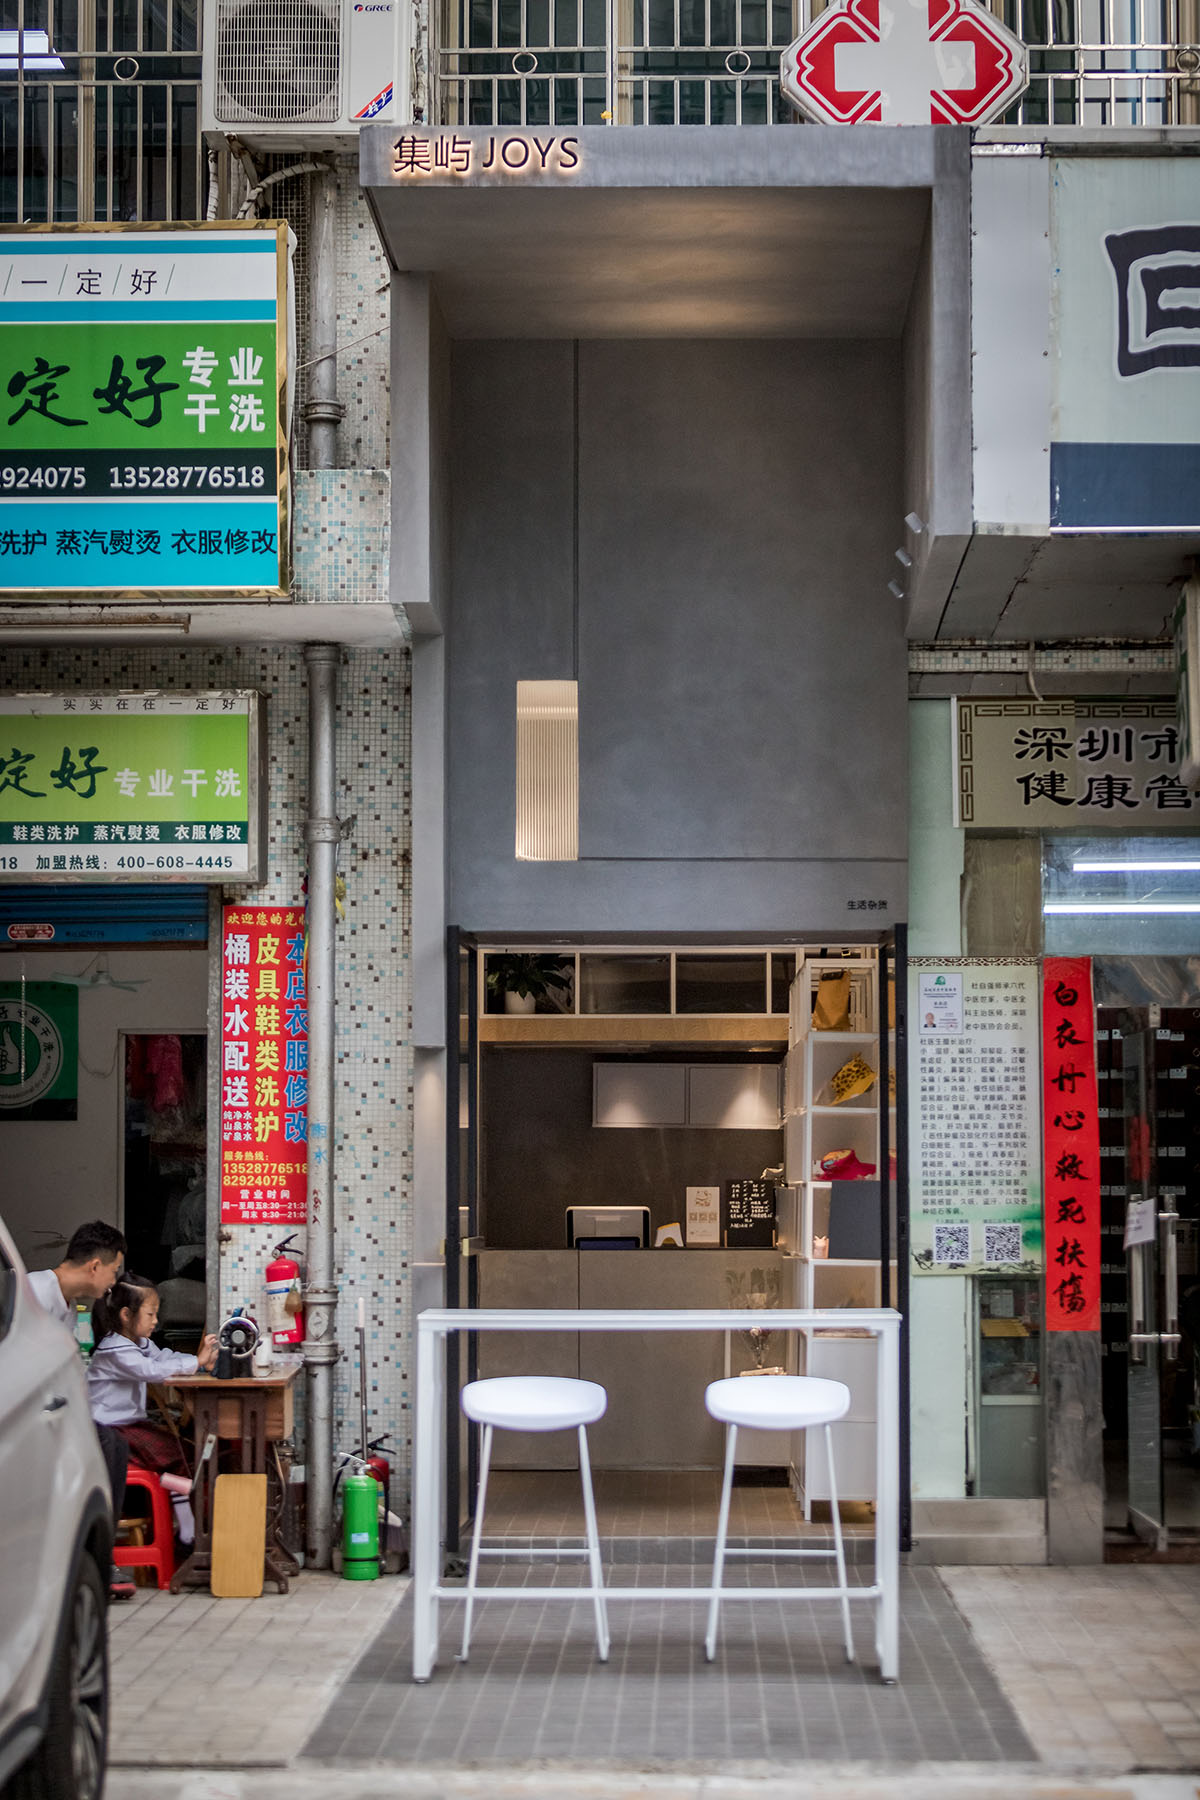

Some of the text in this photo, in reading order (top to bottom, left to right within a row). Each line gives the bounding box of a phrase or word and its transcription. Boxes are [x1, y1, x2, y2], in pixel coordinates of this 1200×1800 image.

[365, 4, 393, 12] GREE
[393, 134, 579, 173] 集屿 JOYS
[182, 346, 264, 387] 专业
[7, 354, 180, 427] 定好
[184, 393, 266, 433] 干洗
[0, 466, 265, 489] 924075 13528776518
[55, 529, 162, 556] 蒸汽熨烫
[171, 528, 278, 555] 衣服修改
[113, 768, 241, 798] 专业干洗
[1016, 770, 1200, 809] 健康管
[13, 825, 241, 841] 鞋类洗护 蒸汽熨烫 衣服修改
[116, 856, 233, 868] 400-608-4445
[847, 900, 888, 910] 生活杂货
[224, 933, 250, 1107] 桶装水配送
[254, 933, 280, 1142] 皮具鞋类洗护
[223, 1122, 252, 1131] 山泉水
[223, 1132, 252, 1141] 矿泉水
[223, 1175, 286, 1186] 82924075
[240, 1189, 290, 1199] 营业时间
